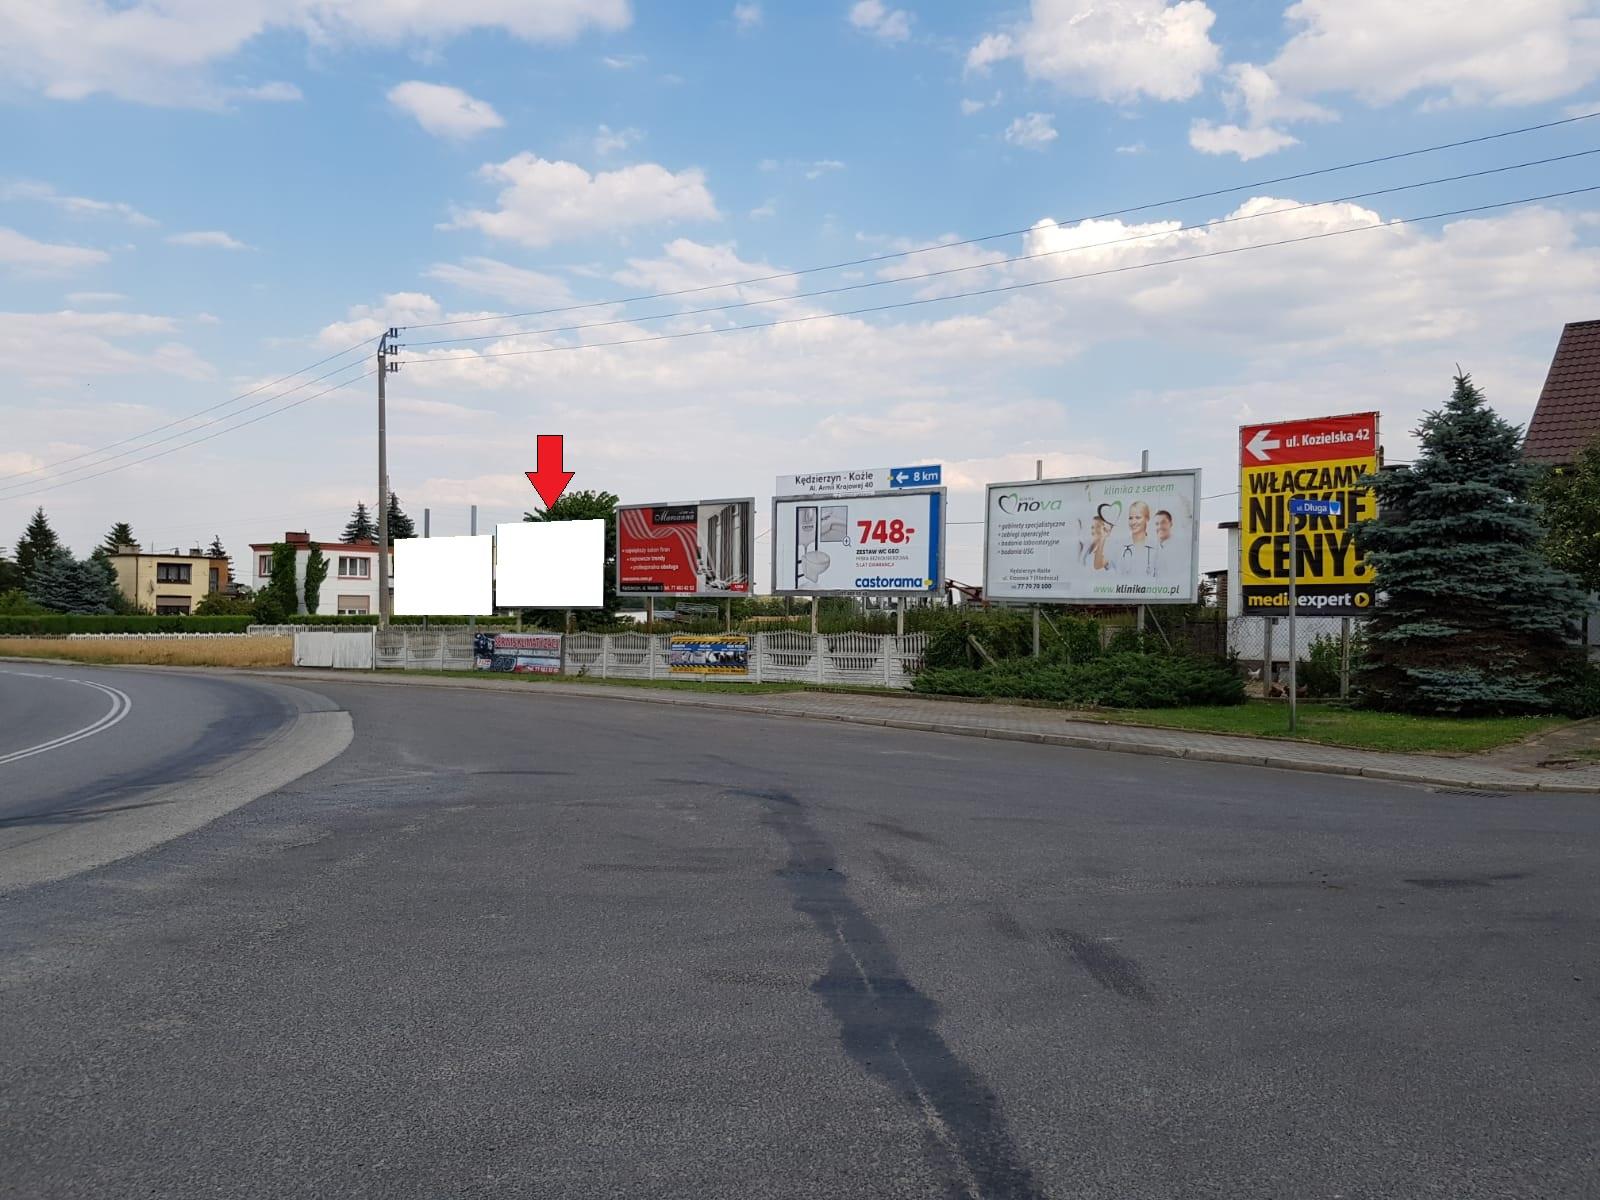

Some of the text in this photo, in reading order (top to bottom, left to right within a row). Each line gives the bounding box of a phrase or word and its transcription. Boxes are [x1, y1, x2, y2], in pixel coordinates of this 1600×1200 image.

[1286, 429, 1370, 448] ul. Kozielska 42
[795, 473, 841, 486] Kędzierzyn
[849, 471, 874, 481] Koźle
[913, 471, 939, 481] 8 km
[1249, 464, 1367, 494] WŁĄCZAMY
[836, 482, 864, 491] Krajowej
[1104, 483, 1175, 495] klinika z sercem
[1017, 500, 1062, 512] nova
[1304, 503, 1327, 513] Długa
[855, 575, 923, 588] castorama
[1093, 583, 1180, 594] www.klinikanova.pl
[1248, 592, 1352, 608] mediexpert
